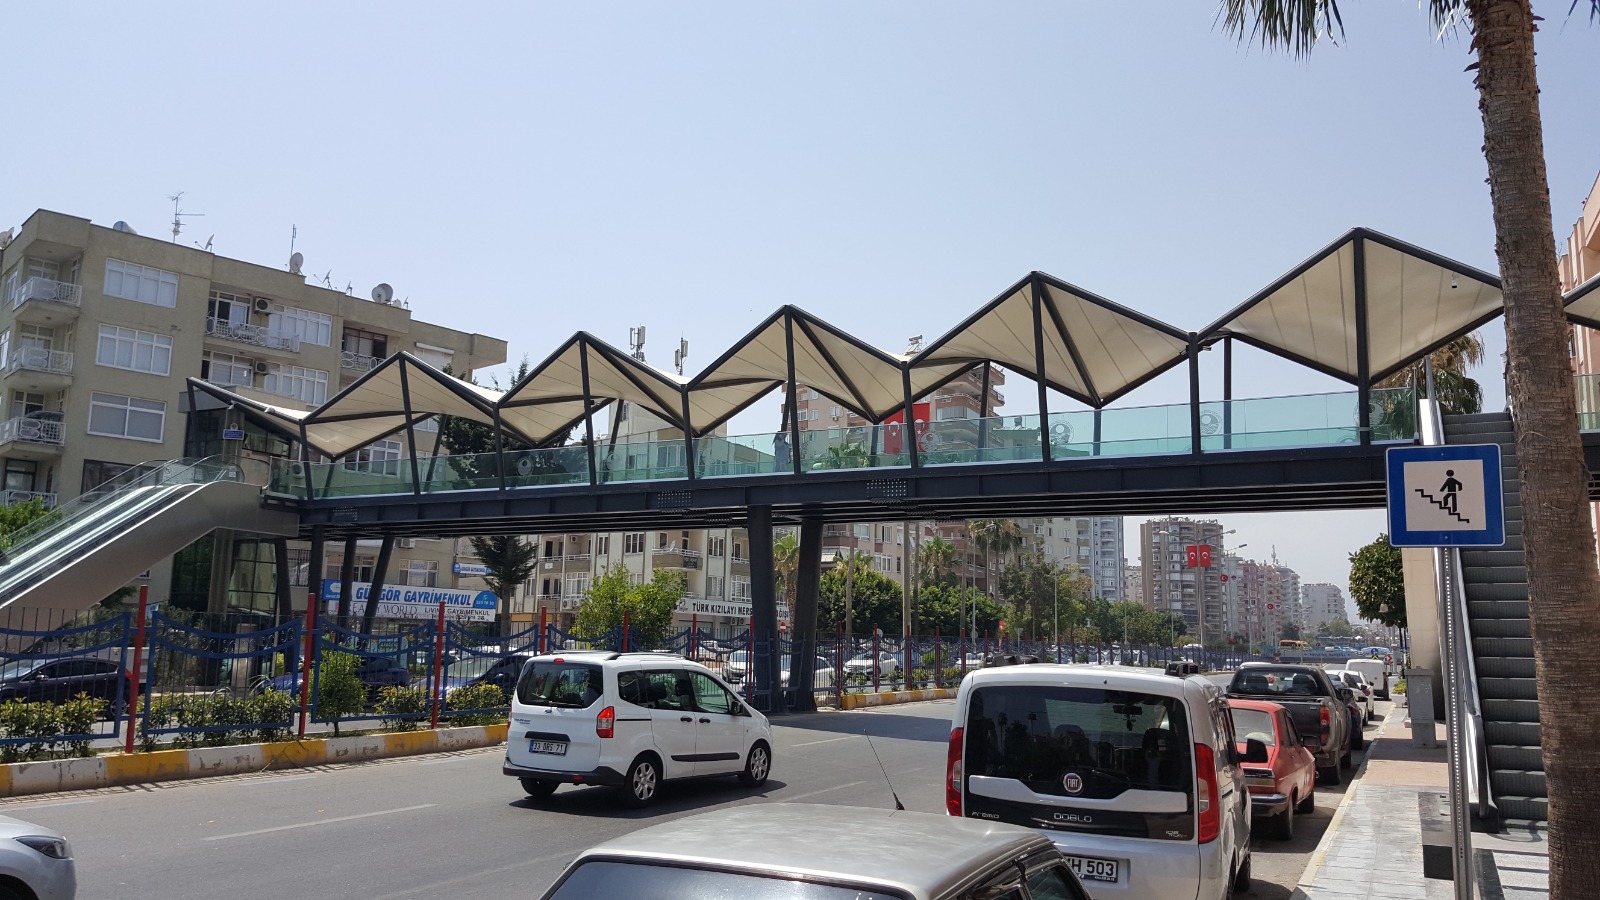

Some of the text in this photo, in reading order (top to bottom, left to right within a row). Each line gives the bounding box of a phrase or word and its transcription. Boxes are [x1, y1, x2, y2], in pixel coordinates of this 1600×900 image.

[356, 584, 471, 605] GÜGÖR GAYRİMENKUL
[383, 603, 418, 615] WORLD
[692, 601, 709, 613] TÜRK
[738, 604, 753, 616] MERS
[533, 742, 541, 751] 33
[555, 743, 564, 753] 71
[1067, 778, 1079, 788] FIAT
[1053, 812, 1092, 823] DOBLO
[1086, 860, 1114, 877] 503
